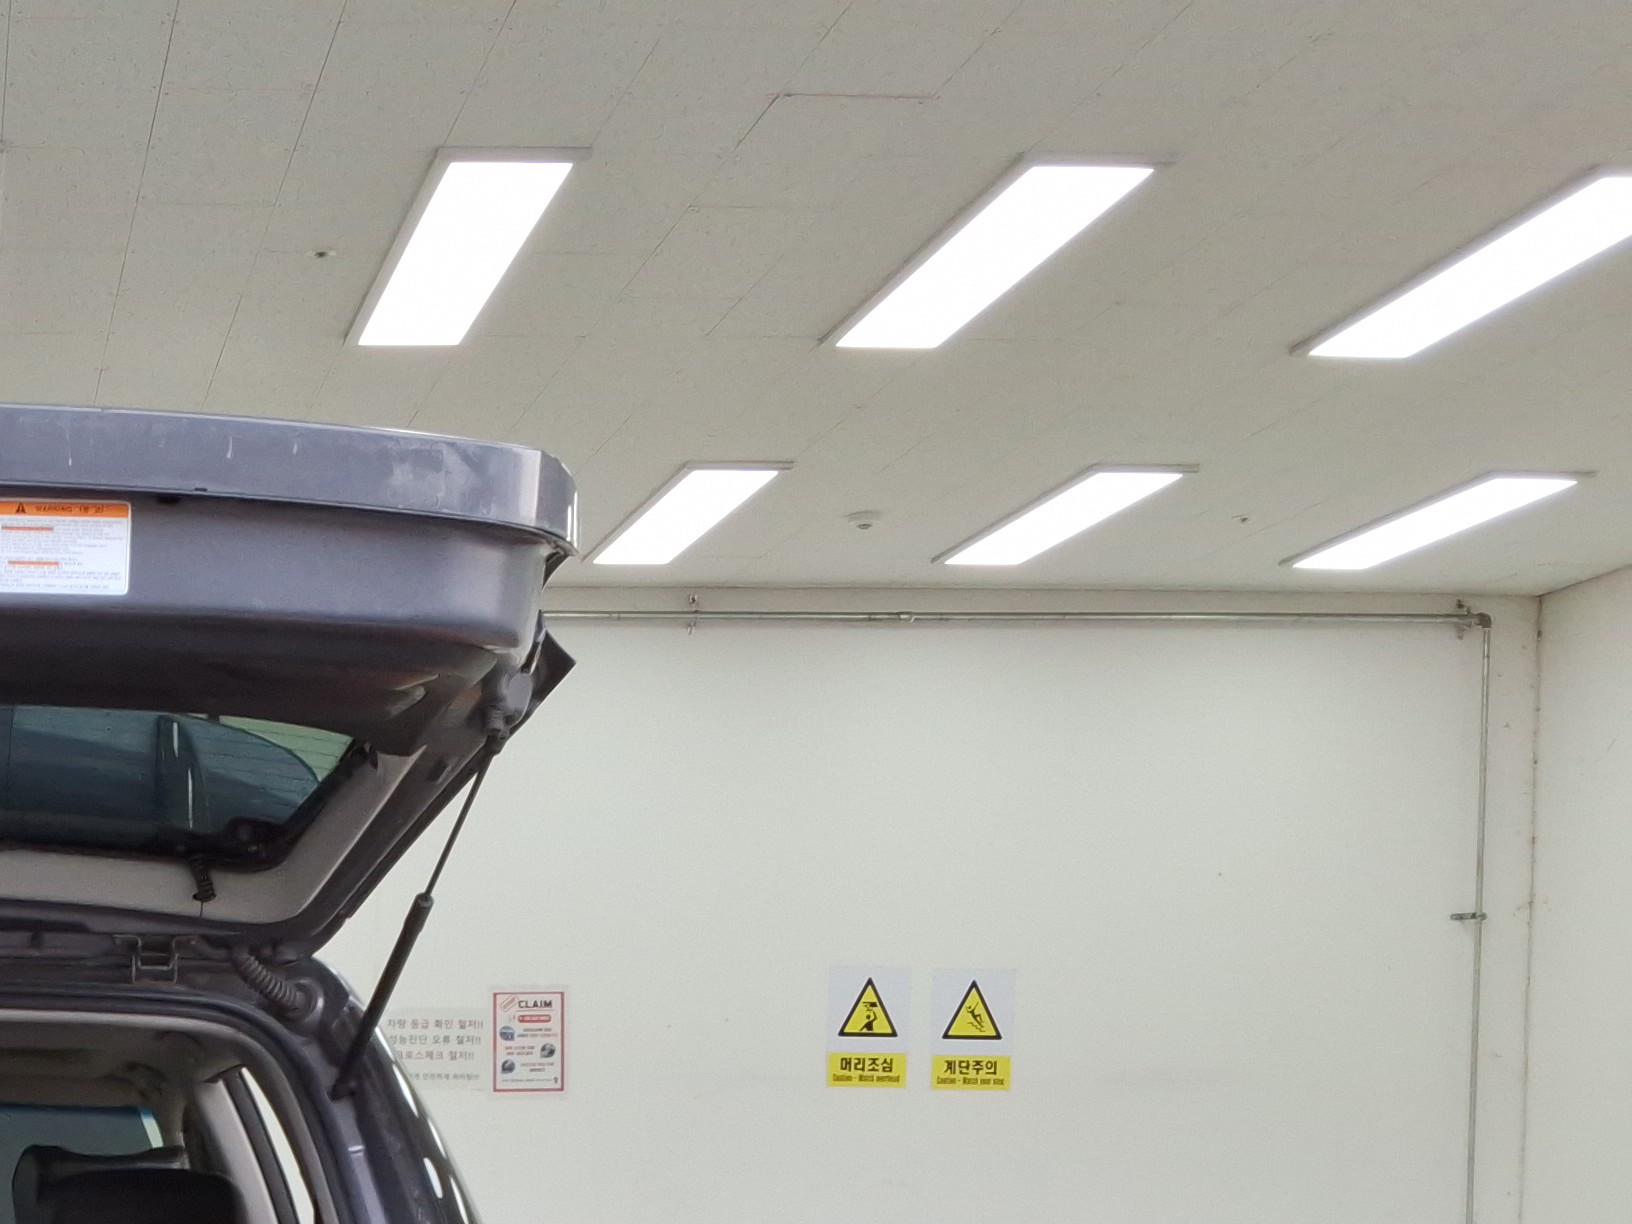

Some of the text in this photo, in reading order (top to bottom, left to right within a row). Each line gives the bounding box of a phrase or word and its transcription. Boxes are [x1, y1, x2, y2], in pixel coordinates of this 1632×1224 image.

[518, 1000, 553, 1009] CLAIM
[840, 1057, 894, 1073] 머리조심
[944, 1060, 998, 1076] 계단주의
